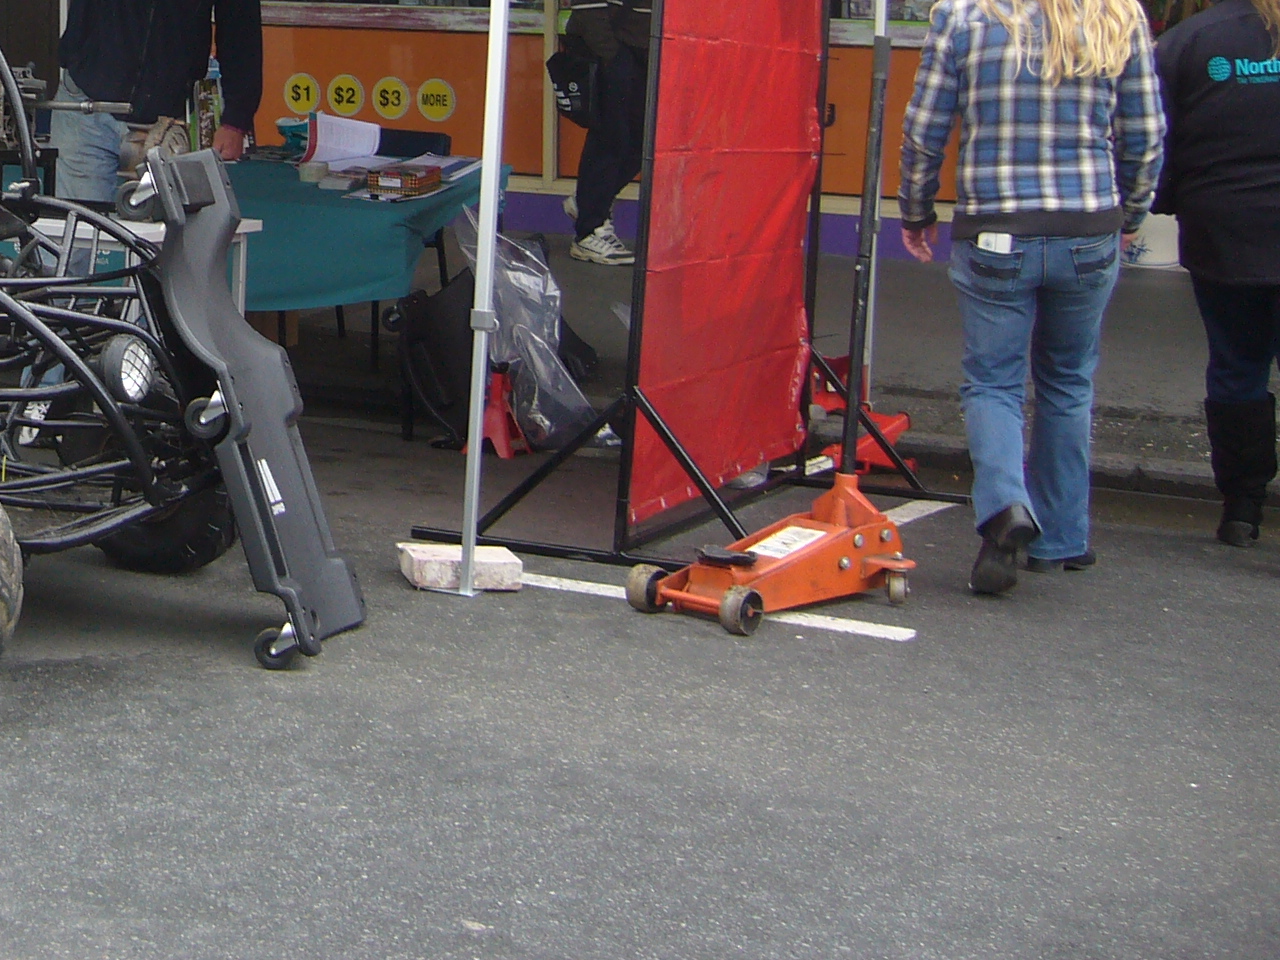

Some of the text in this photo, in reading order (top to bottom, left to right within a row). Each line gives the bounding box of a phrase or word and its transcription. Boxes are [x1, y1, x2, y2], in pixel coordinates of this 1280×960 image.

[291, 84, 311, 102] $1
[334, 87, 356, 105] $2
[379, 89, 402, 108] $3
[421, 93, 448, 107] MORE
